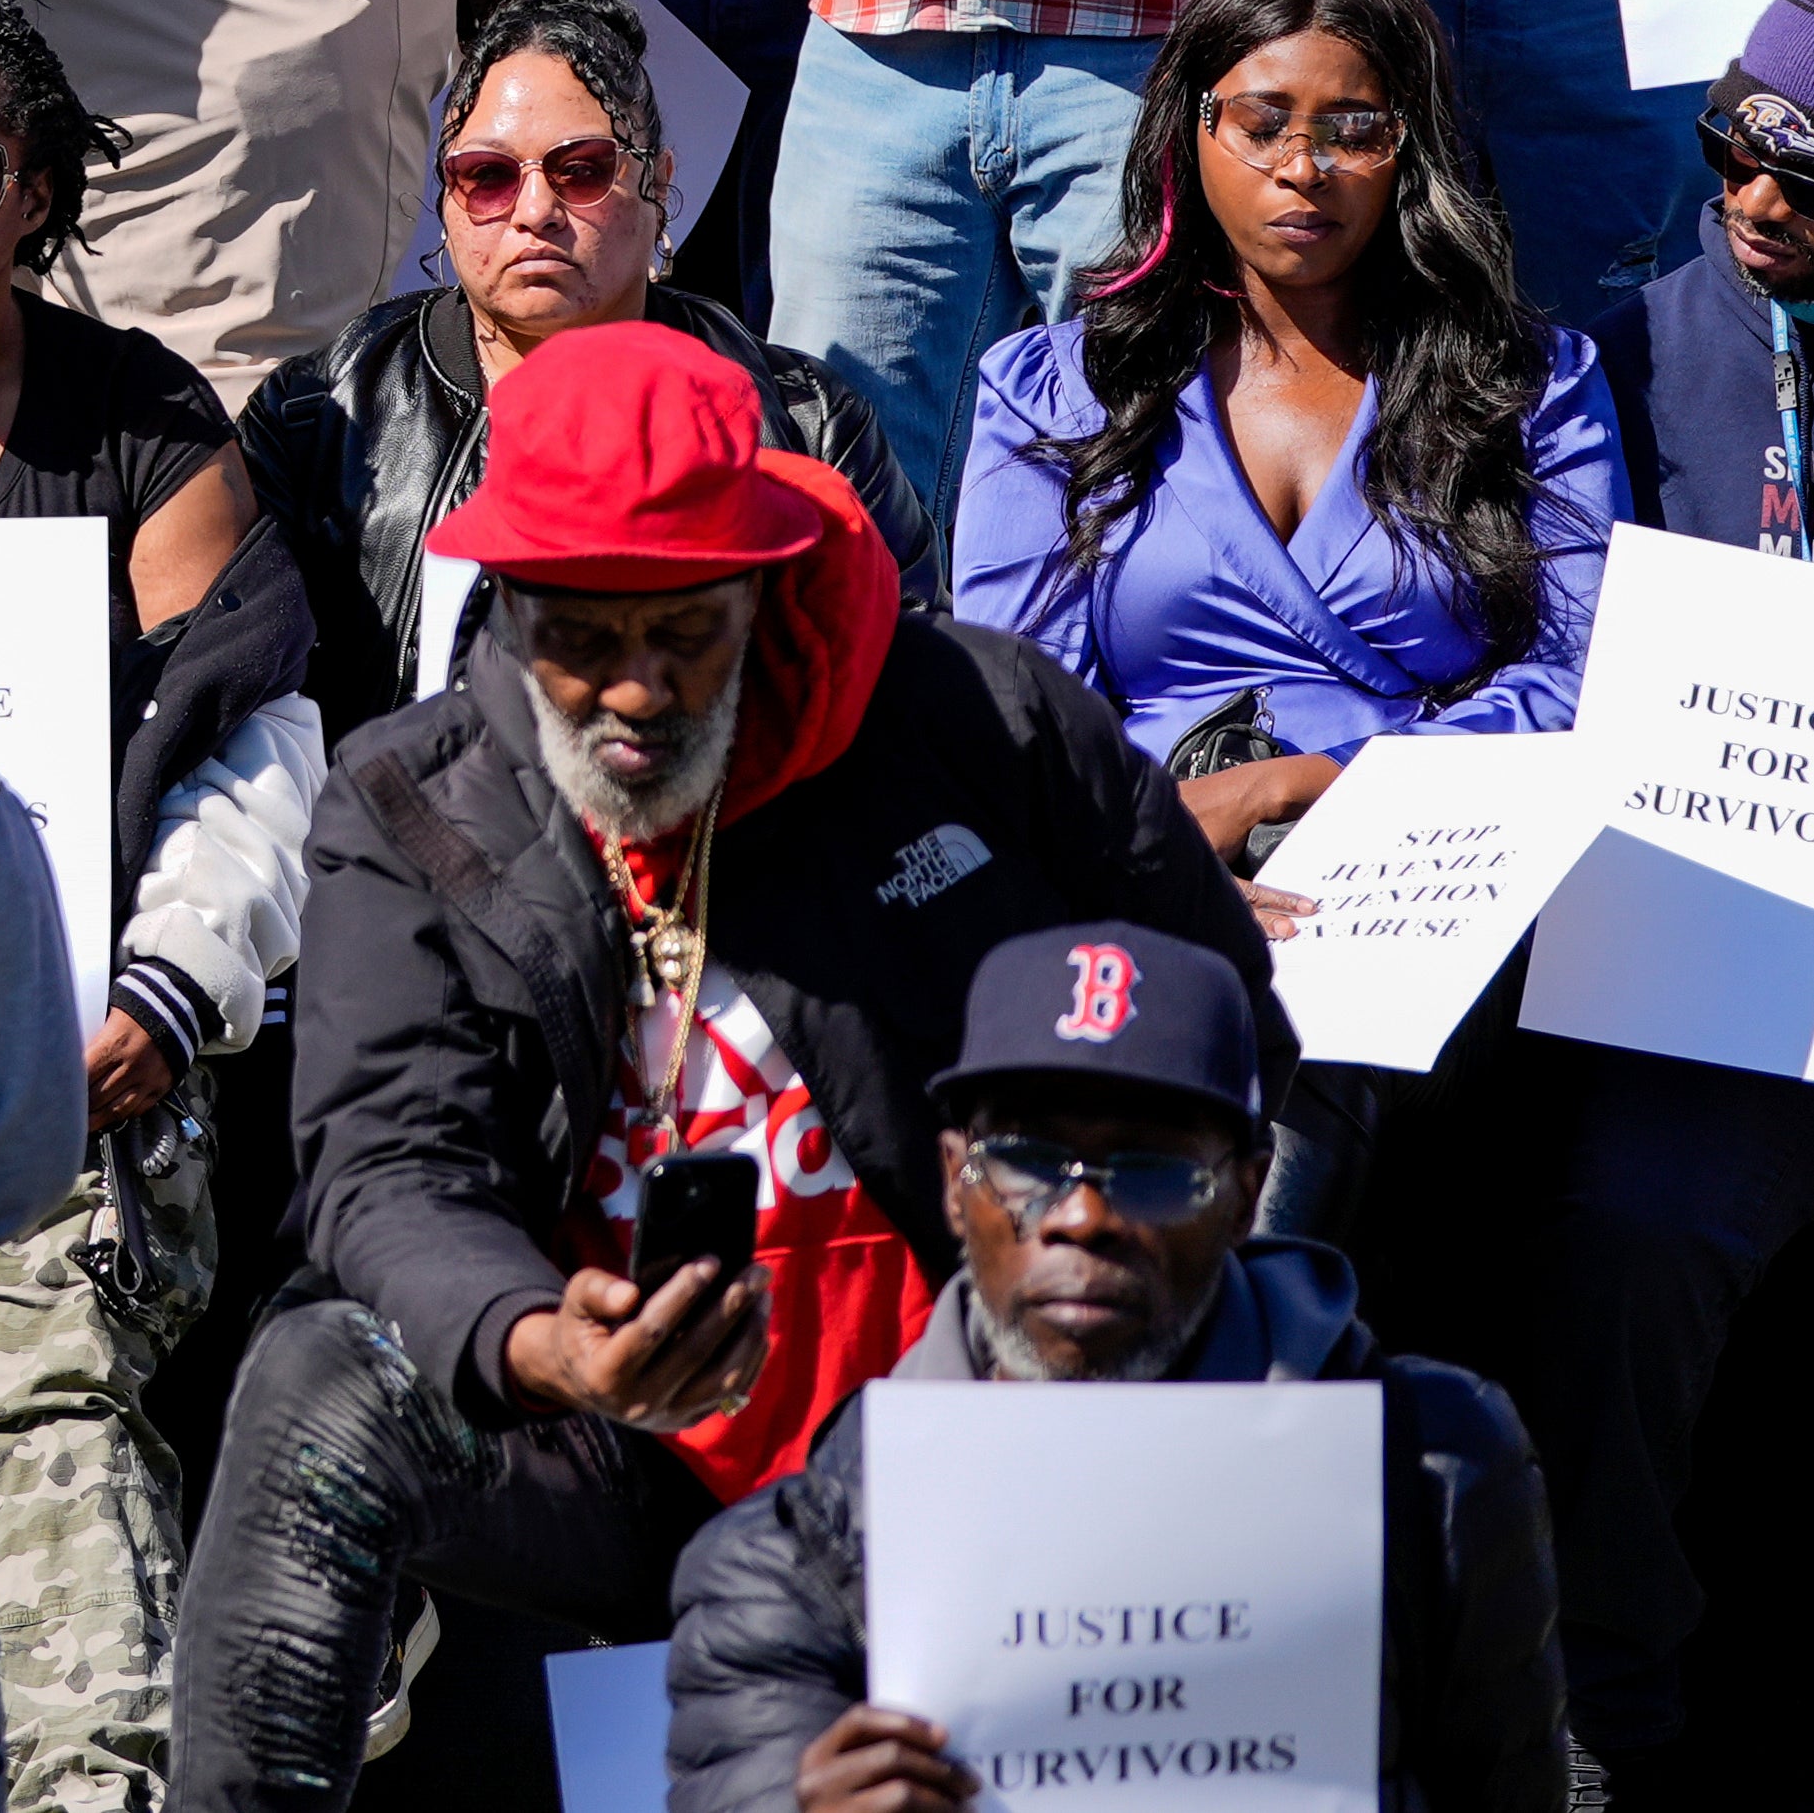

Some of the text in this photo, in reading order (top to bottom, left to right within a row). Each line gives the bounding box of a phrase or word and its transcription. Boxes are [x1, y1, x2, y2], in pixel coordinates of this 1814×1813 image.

[1680, 684, 1814, 730] JUSTI
[1721, 743, 1808, 783] FOR
[894, 831, 941, 868] THE
[1398, 825, 1500, 847] STOP
[876, 846, 954, 904] NORTH
[907, 867, 961, 907] FACE
[1314, 883, 1506, 913] ETENTION
[1055, 943, 1142, 1043] B
[1001, 1601, 1252, 1648] JUSTICE
[1070, 1677, 1184, 1716] FOR
[972, 1732, 1296, 1790] URVIVORS
